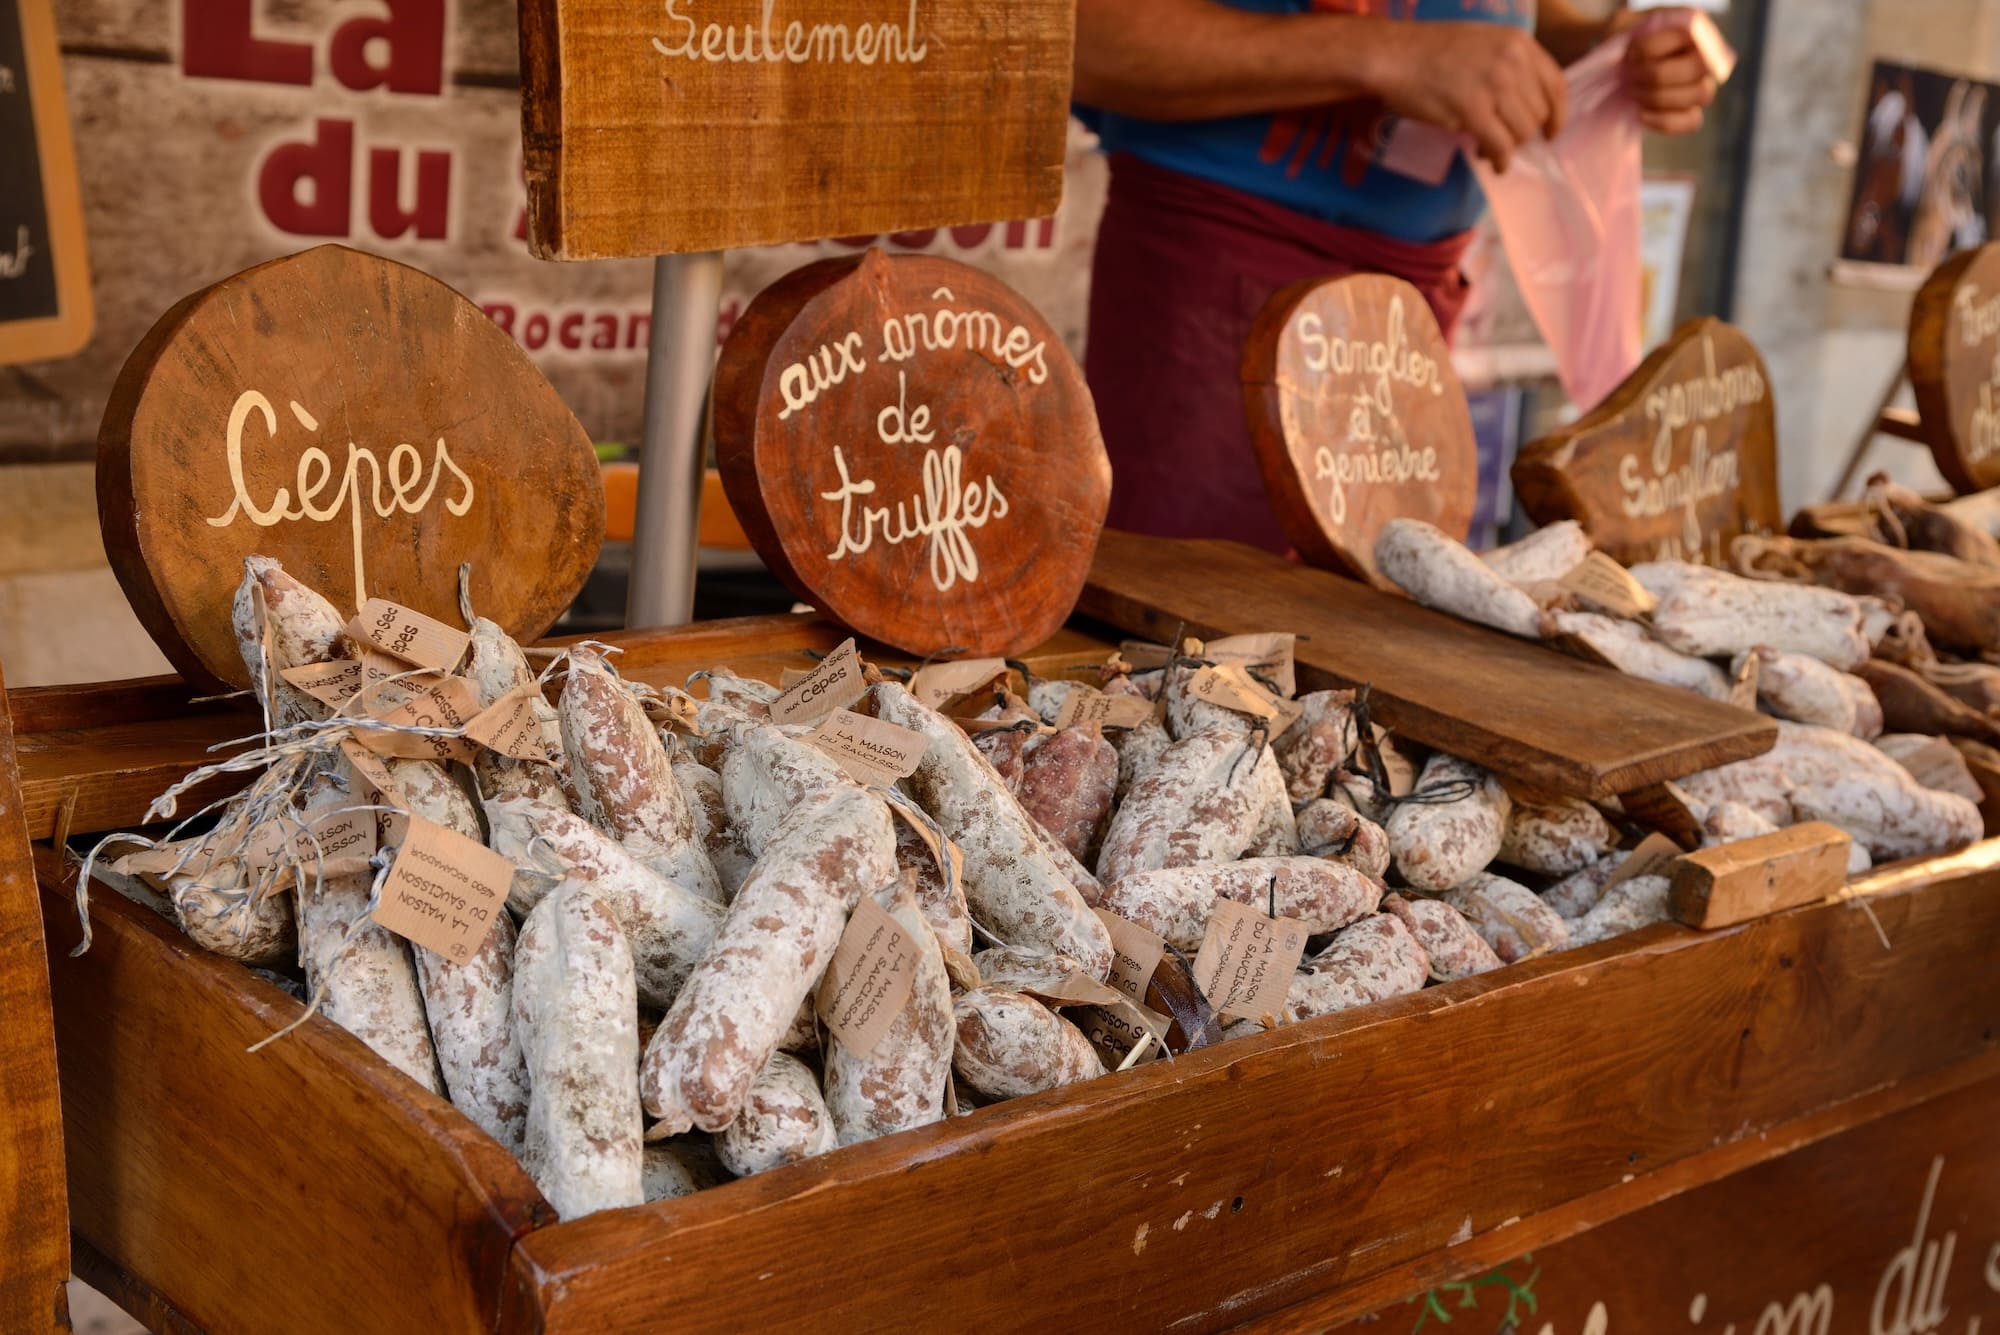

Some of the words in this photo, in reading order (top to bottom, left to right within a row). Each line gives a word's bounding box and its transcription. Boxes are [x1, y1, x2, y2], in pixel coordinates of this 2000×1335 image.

[183, 0, 446, 96] La
[652, 0, 926, 64] Seulement
[258, 118, 452, 241] du
[778, 331, 866, 420] aux
[878, 287, 1048, 384] arômes
[1298, 295, 1443, 417] Sanglier
[877, 370, 935, 443] de
[206, 390, 474, 612] Cèpes
[820, 445, 1008, 591] truffes
[377, 607, 398, 630] Sec
[386, 625, 418, 653] èpes
[345, 661, 362, 676] Se
[784, 702, 800, 714] aux
[801, 667, 847, 703] Cèpes
[818, 734, 837, 744] DU
[841, 744, 908, 773] SAUCISSON
[837, 730, 853, 743] LA
[859, 739, 907, 761] MAISON
[297, 831, 367, 864] AUISSON
[411, 844, 469, 882] ROCAMADOUR
[397, 868, 466, 911] SAUCISSON
[398, 891, 447, 922] MAISON
[452, 916, 470, 934] LA
[469, 907, 488, 921] DU
[1253, 921, 1266, 939] DU
[887, 932, 901, 953] DU
[1261, 935, 1278, 954] LA
[890, 953, 906, 972] LA
[839, 957, 887, 1030] SAUCISSON
[1123, 979, 1138, 993] DU
[1243, 960, 1267, 1005] MAISON
[854, 978, 892, 1030] MAISON
[1091, 1026, 1134, 1055] Cèpe
